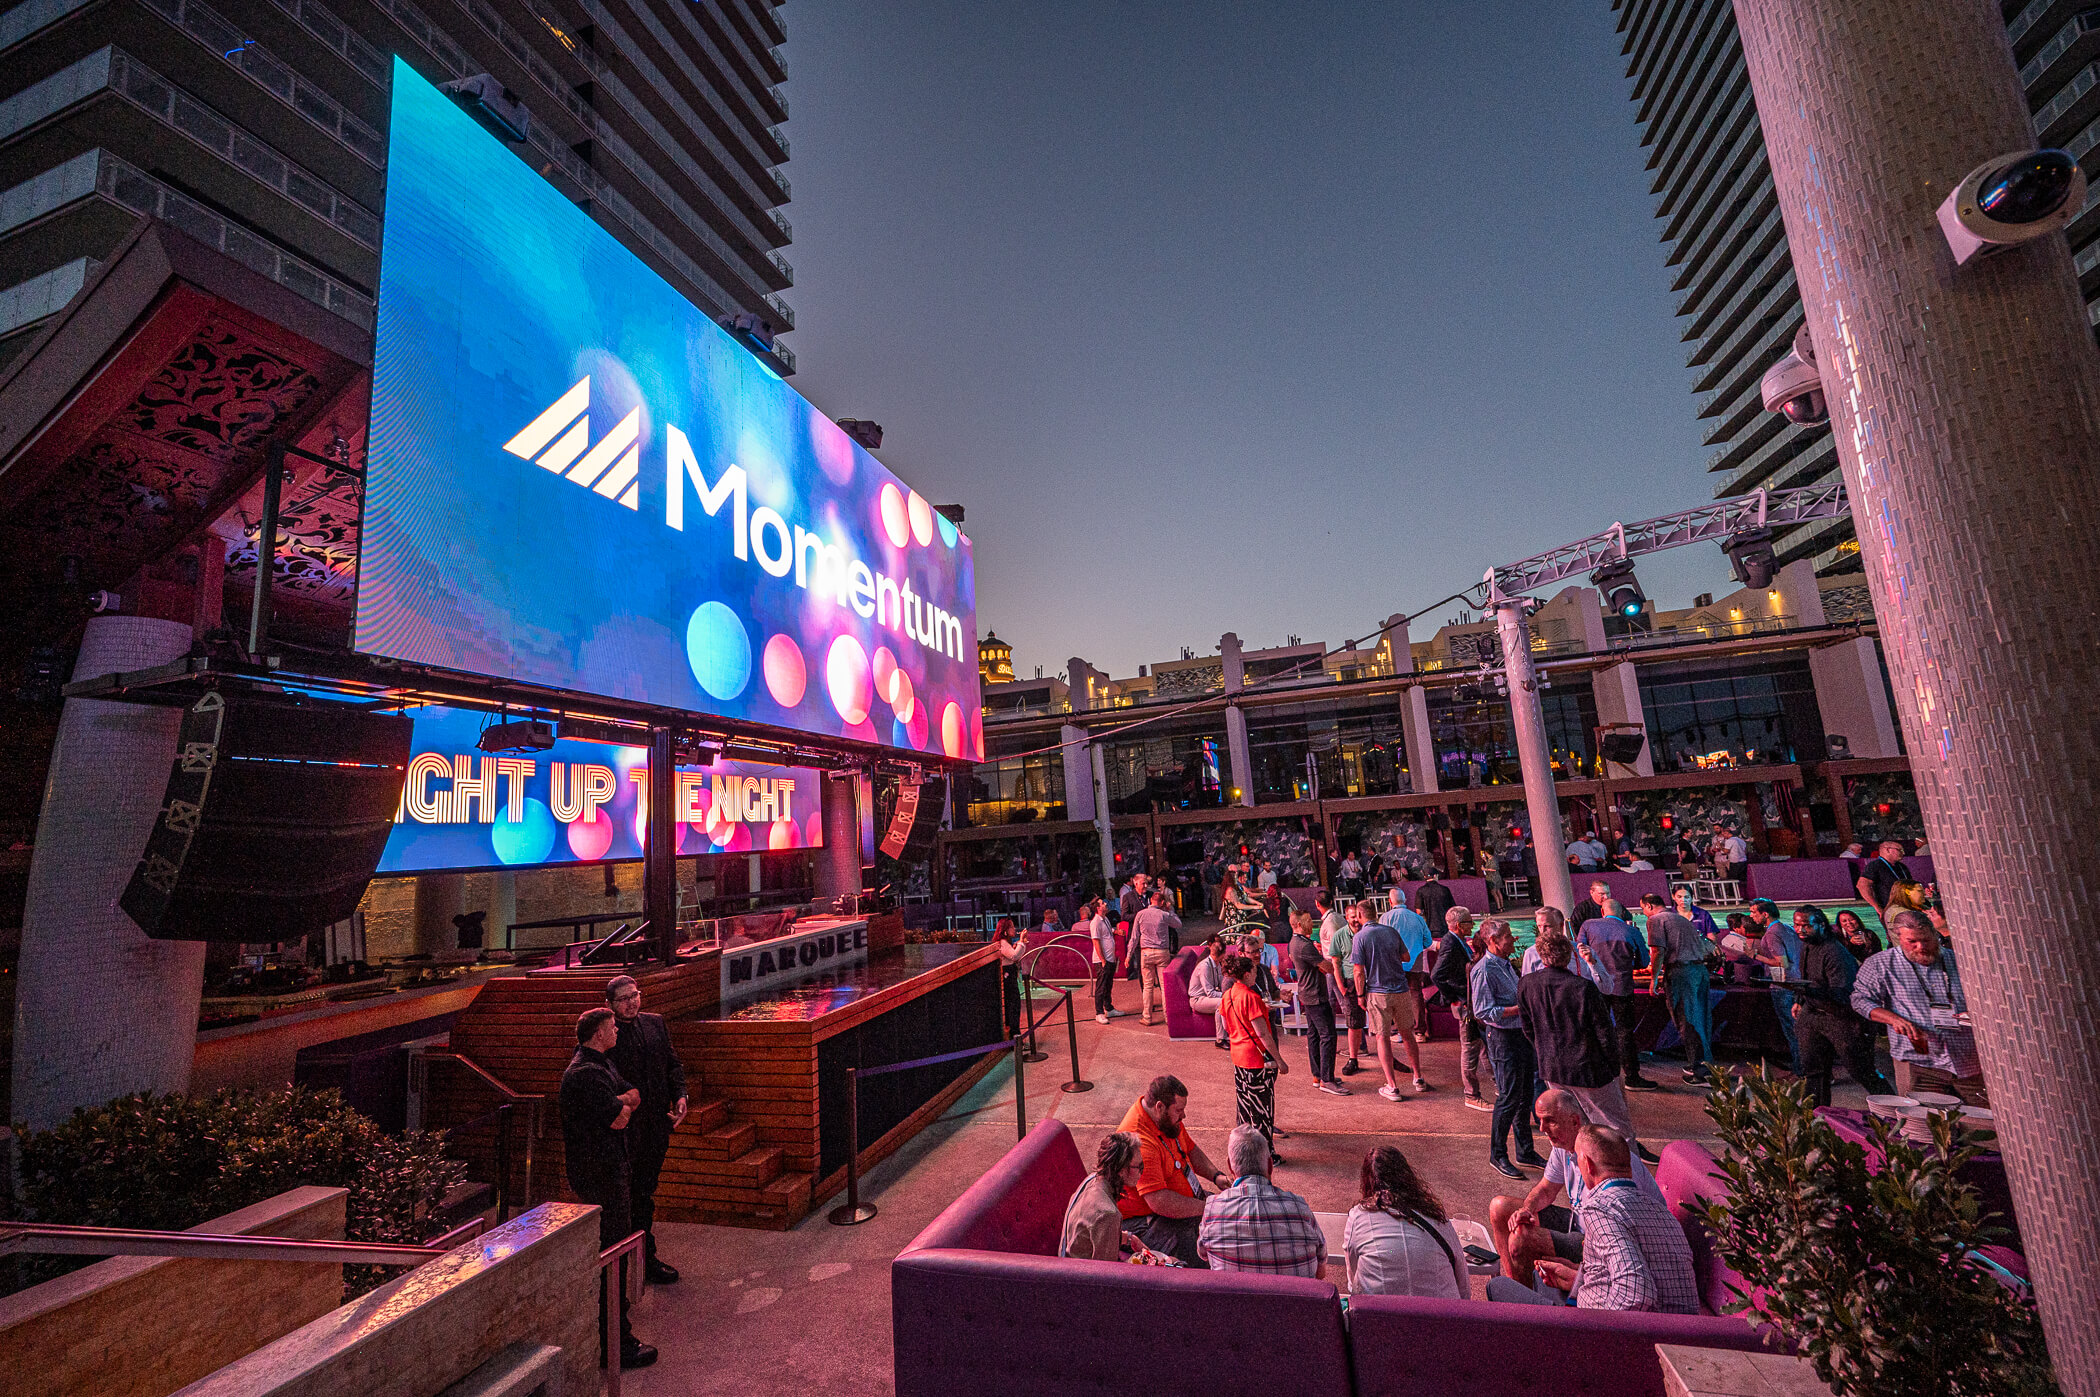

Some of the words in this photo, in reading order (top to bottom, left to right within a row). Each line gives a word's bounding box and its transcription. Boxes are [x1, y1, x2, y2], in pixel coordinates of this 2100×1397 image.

[666, 422, 964, 662] Momentum
[551, 761, 617, 823] UP
[711, 774, 796, 822] NIGHT
[729, 928, 868, 984] MARQUEE
